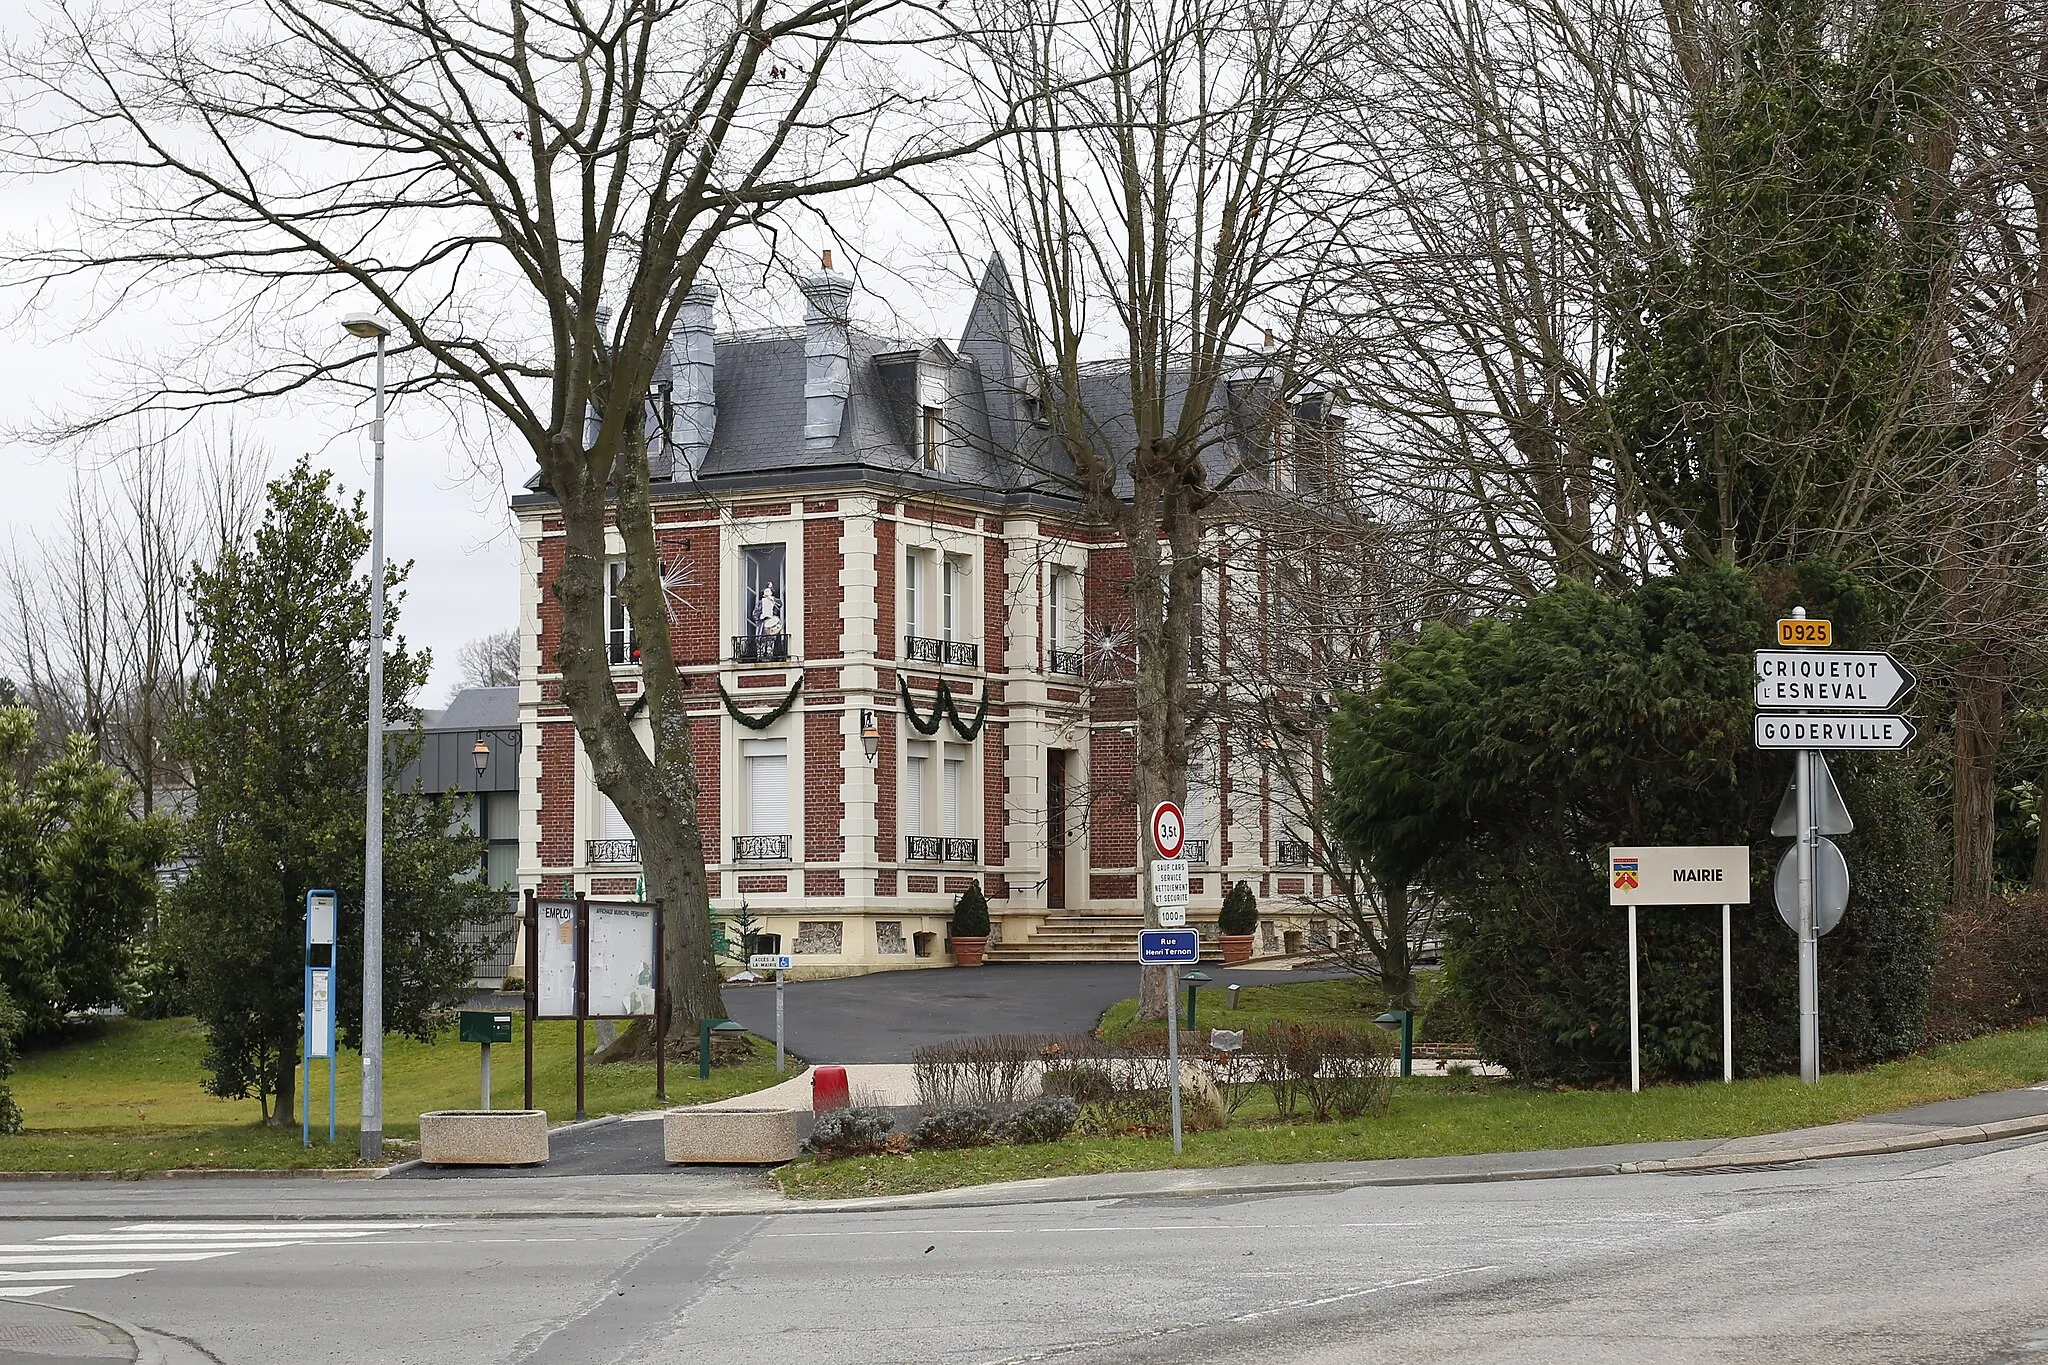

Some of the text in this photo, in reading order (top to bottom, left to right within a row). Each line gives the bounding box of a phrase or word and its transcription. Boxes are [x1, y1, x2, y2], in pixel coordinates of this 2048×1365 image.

[1783, 625, 1827, 641] D925
[1763, 660, 1878, 678] CRIQUETOT
[1765, 723, 1893, 740] GODERVILLE
[1161, 824, 1177, 840] 3,5t
[1156, 863, 1185, 872] SAUF CARS
[1160, 874, 1182, 882] SERVICE
[1673, 869, 1723, 882] MAIRIE
[1154, 884, 1188, 892] NETTOIEMENT
[1156, 895, 1162, 903] ET
[545, 907, 571, 919] EMPLOI
[1145, 948, 1164, 956] Henri
